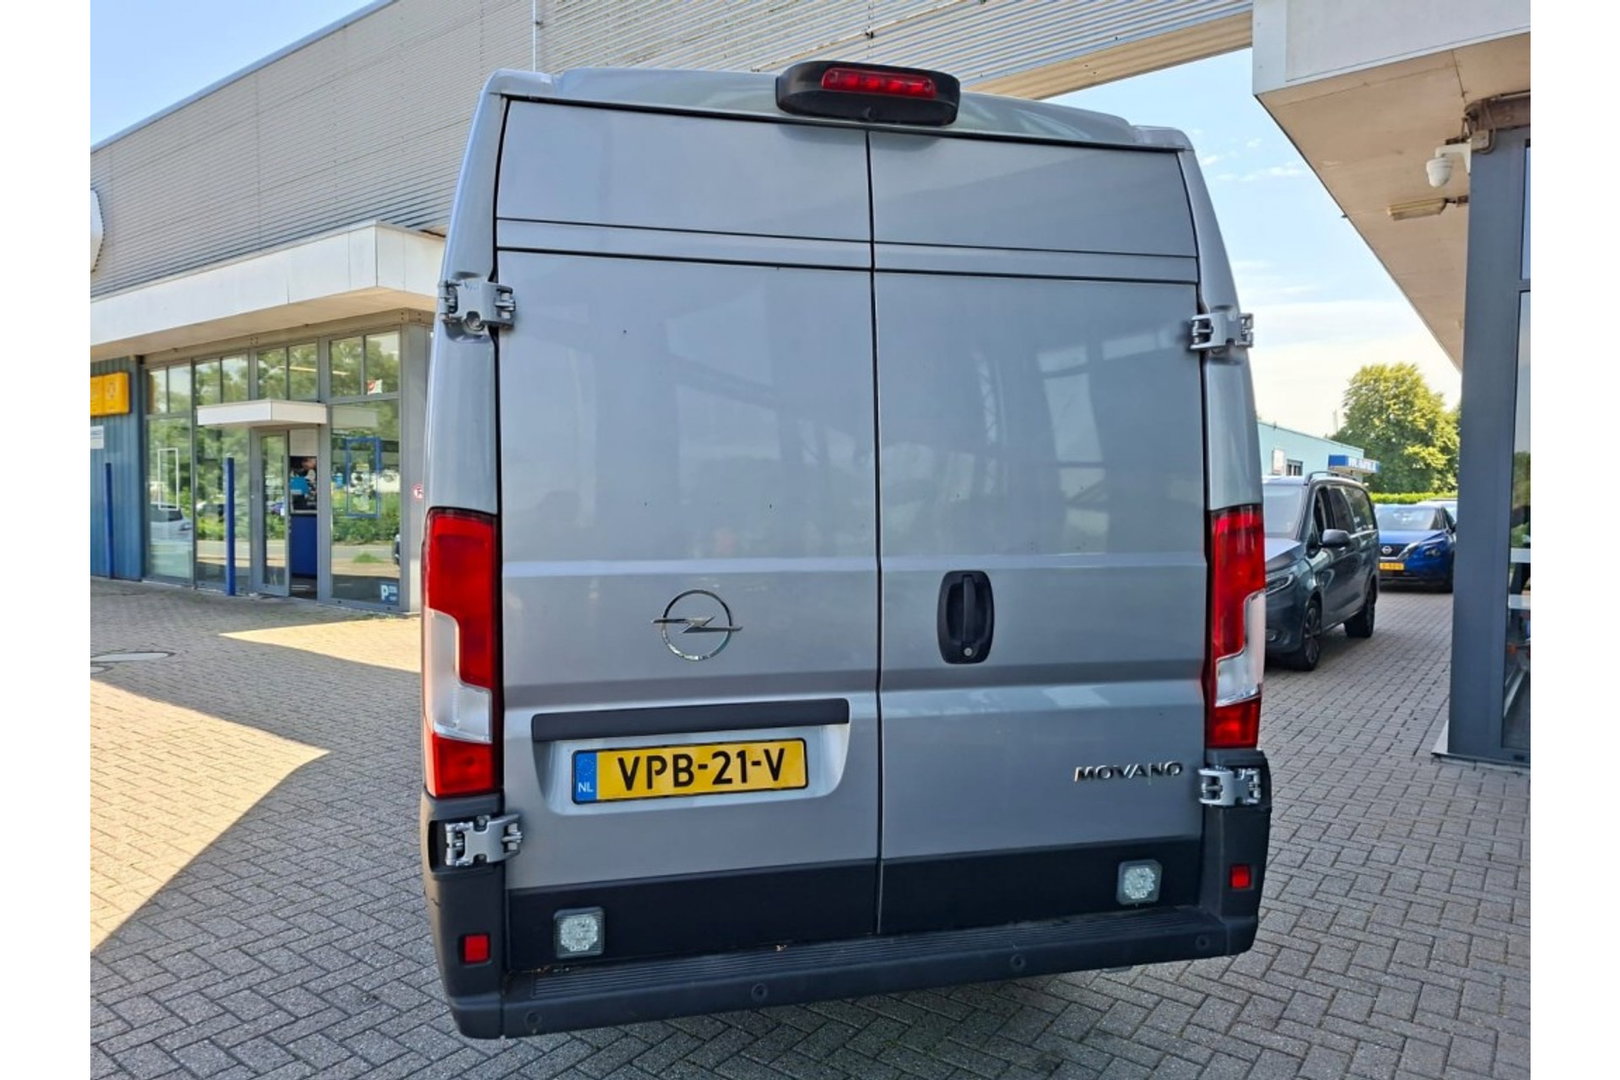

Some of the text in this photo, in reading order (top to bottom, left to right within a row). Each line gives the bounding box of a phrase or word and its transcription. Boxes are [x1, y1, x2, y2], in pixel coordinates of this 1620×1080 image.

[617, 748, 785, 791] VPB-21-V
[1074, 761, 1183, 782] MOVANO
[578, 781, 593, 793] NL
